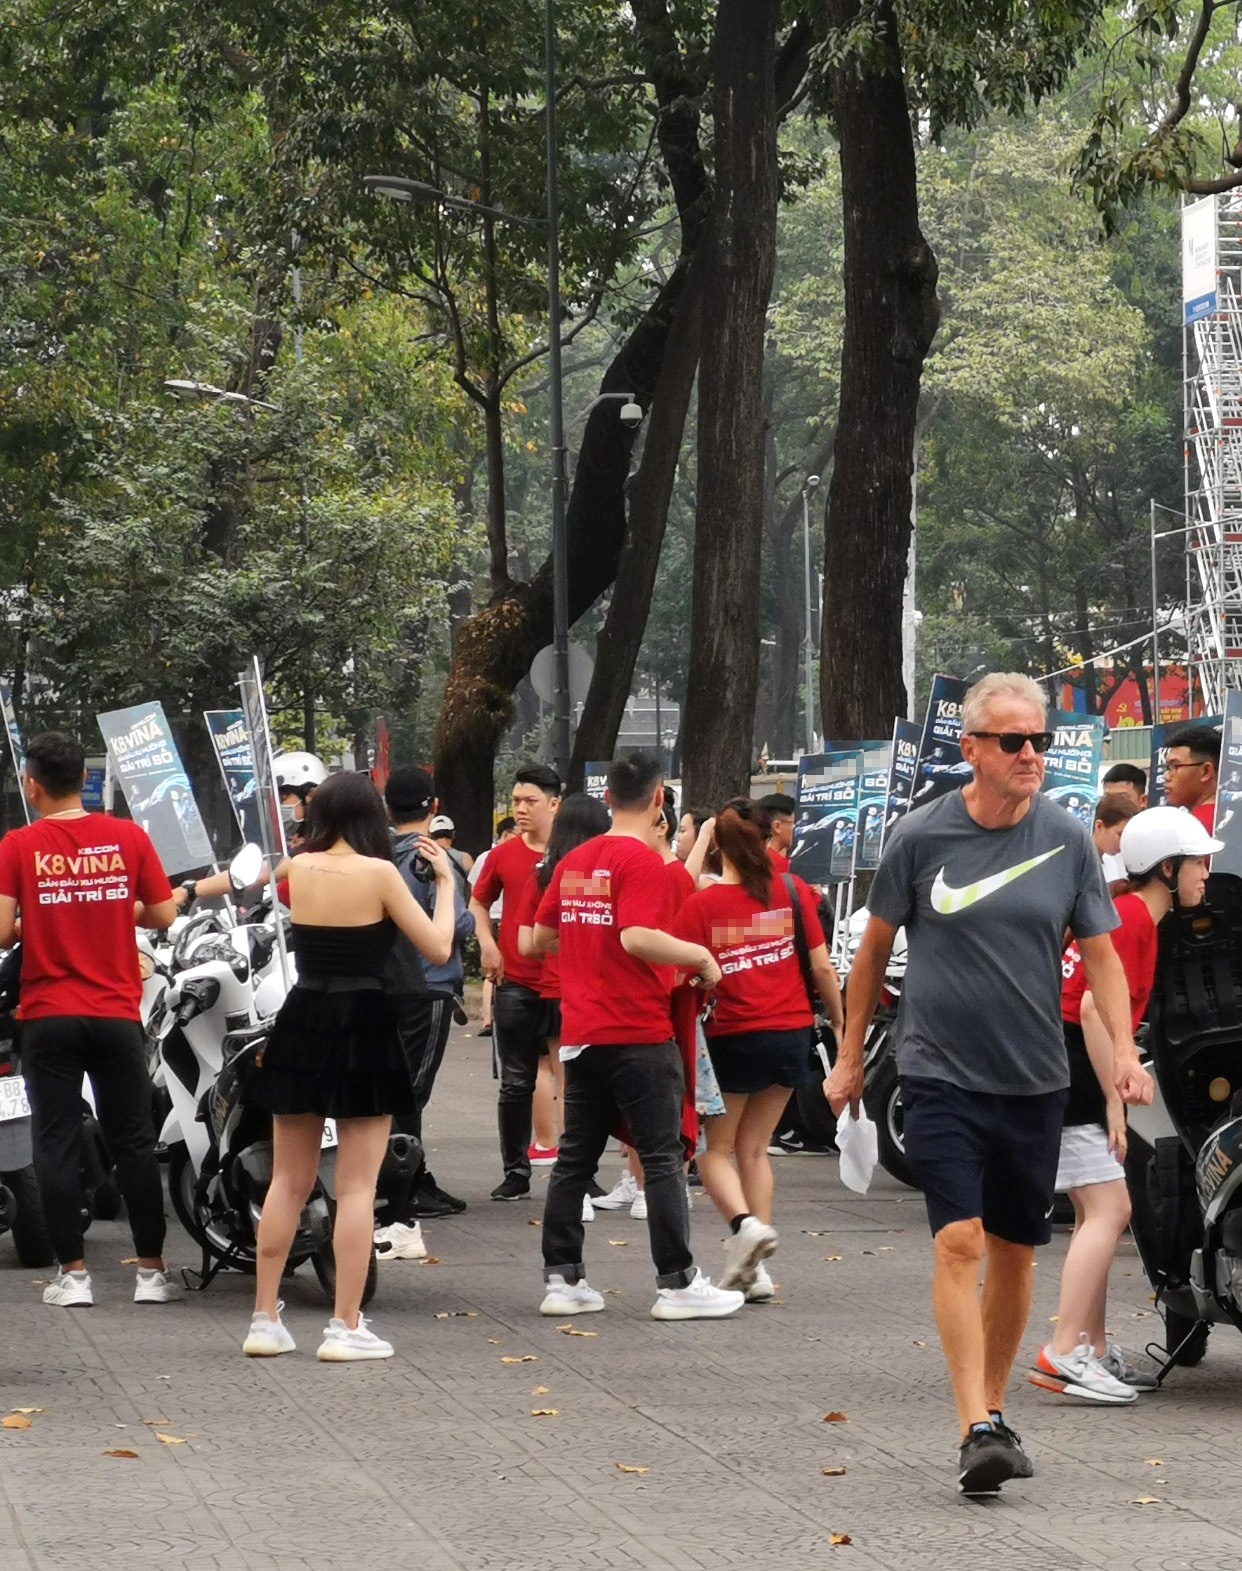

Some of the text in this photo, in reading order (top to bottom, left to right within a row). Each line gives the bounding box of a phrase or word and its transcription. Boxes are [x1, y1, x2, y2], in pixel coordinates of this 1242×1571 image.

[109, 720, 164, 756] K8VINA
[152, 747, 174, 766] SỐ
[1058, 748, 1092, 757] HƯỚNG
[1065, 757, 1092, 774] SỐ
[833, 787, 855, 800] SỐ
[34, 851, 126, 876] K8VINA
[80, 878, 94, 887] XU
[94, 874, 128, 885] HƯỚNG
[39, 882, 129, 904] GIẢI TRÍ SỐ
[721, 956, 753, 974] GIẢI
[752, 948, 780, 966] TRÍ
